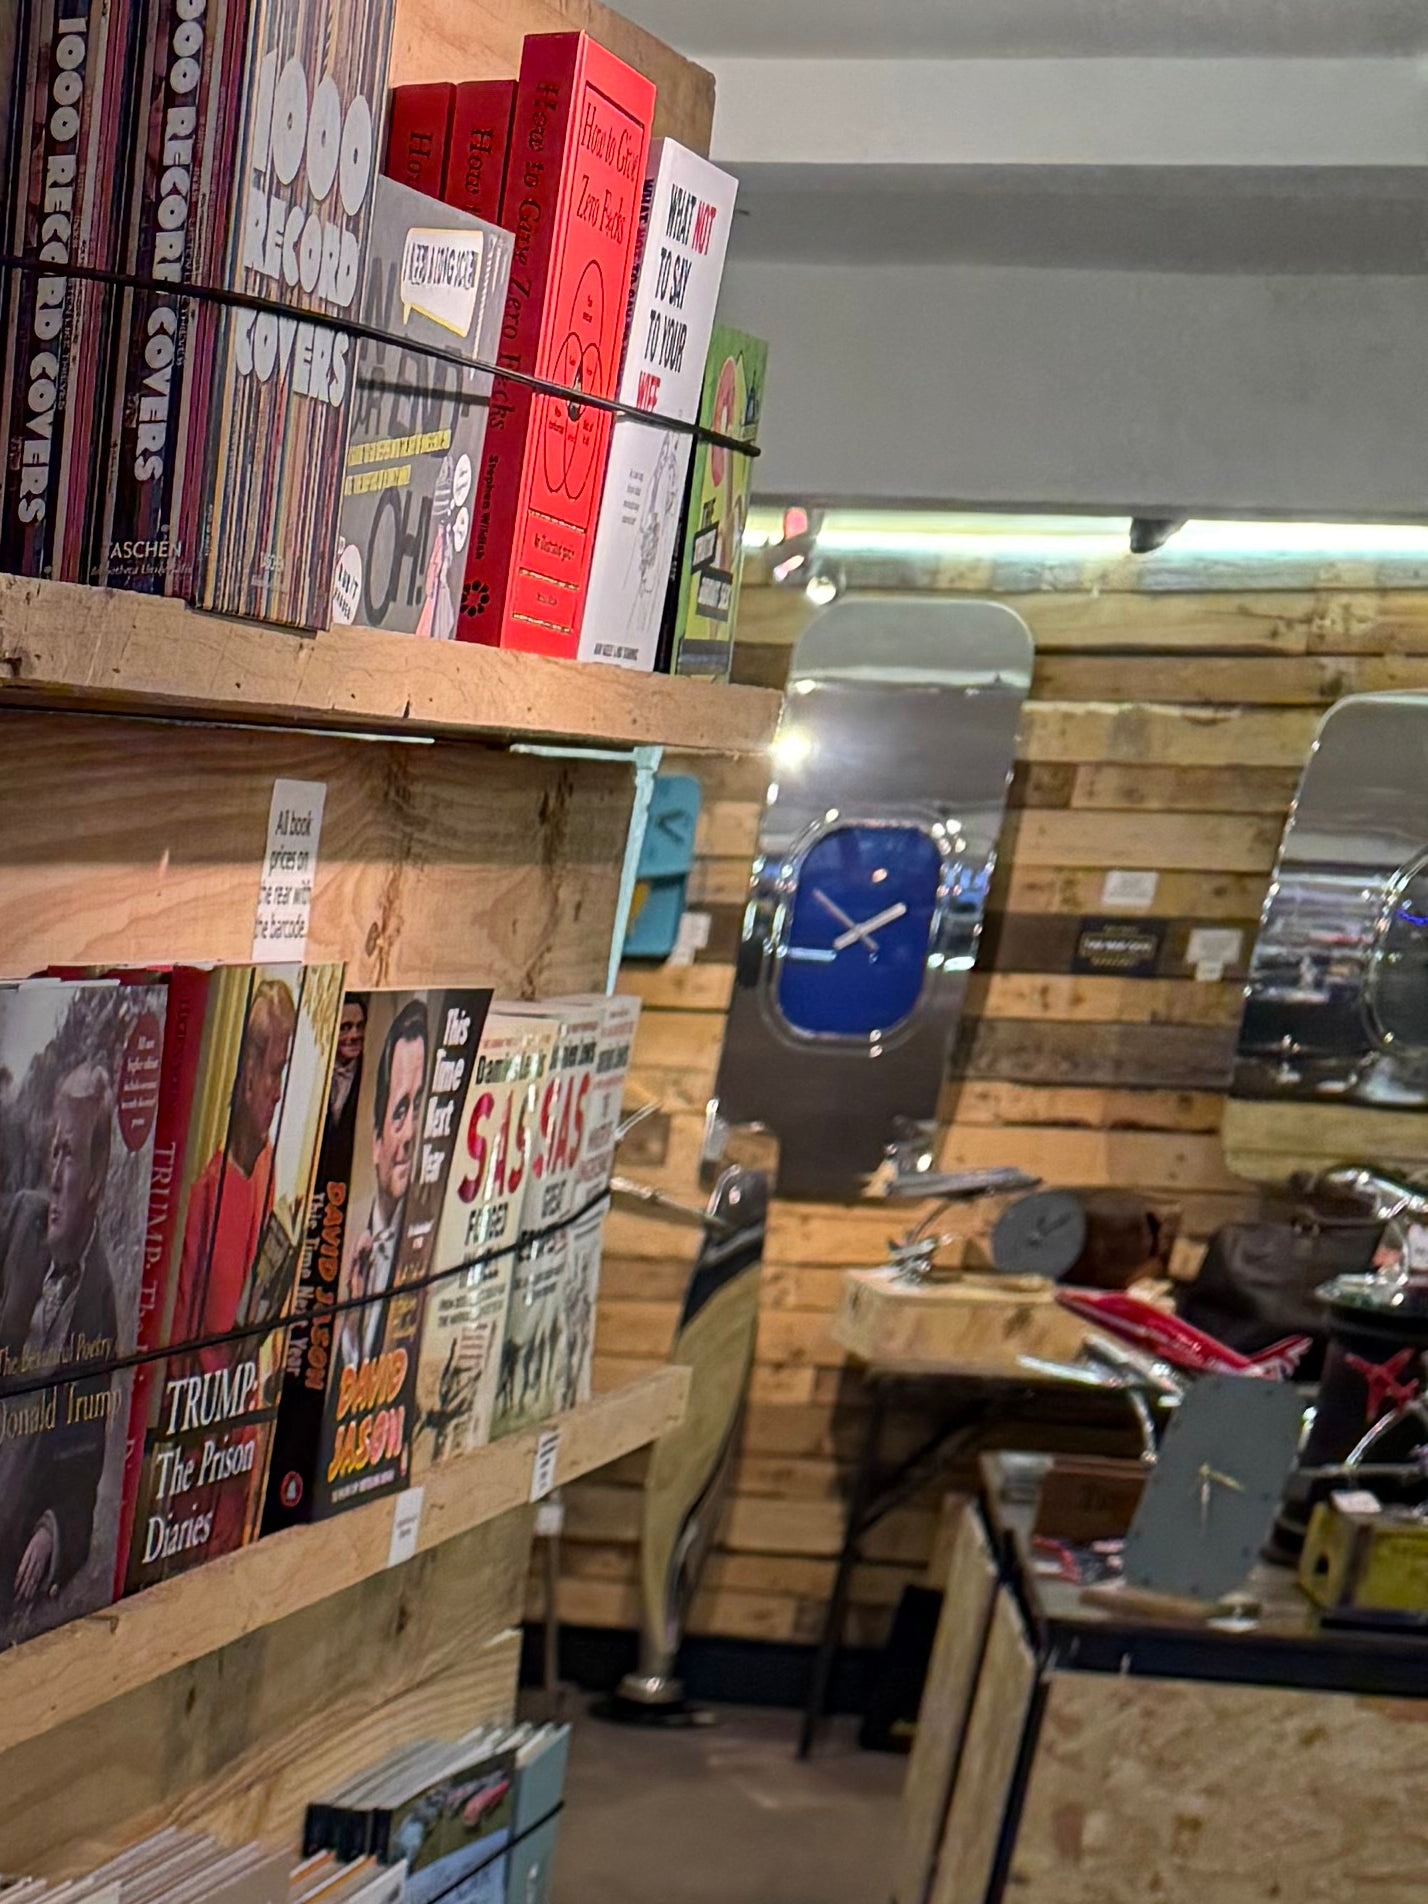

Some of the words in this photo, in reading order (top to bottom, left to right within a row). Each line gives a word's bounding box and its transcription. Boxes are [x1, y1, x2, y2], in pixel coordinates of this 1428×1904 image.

[48, 16, 87, 143] 1000
[251, 46, 372, 217] 1000
[527, 80, 560, 156] How
[579, 101, 606, 157] How
[605, 122, 617, 165] to
[616, 131, 640, 183] Give
[464, 127, 495, 205] How
[523, 157, 545, 187] to
[575, 173, 599, 229] Zero
[33, 153, 78, 341] RECORD
[245, 180, 360, 307] RECORD
[514, 196, 543, 266] Give
[664, 183, 697, 246] WHAT
[691, 199, 717, 256] NOT
[499, 268, 533, 341] Zero
[653, 247, 673, 303] TO
[669, 254, 693, 311] SAY
[234, 306, 350, 408] COVERS
[644, 309, 663, 361] TO
[658, 315, 688, 374] YOUR
[134, 305, 178, 483] COVERS
[17, 350, 60, 525] COVERS
[481, 453, 500, 503] Stephen
[275, 810, 290, 836] All
[289, 810, 312, 837] book
[268, 844, 297, 877] prices
[297, 850, 310, 872] on
[442, 1007, 471, 1048] This
[433, 1047, 466, 1093] Time
[422, 1096, 455, 1140] Next
[457, 1084, 533, 1206] SAS
[532, 1071, 592, 1180] SAS
[418, 1143, 446, 1187] Year
[308, 1190, 326, 1230] This
[318, 1180, 347, 1282] DAVID
[301, 1234, 321, 1280] Time
[76, 1331, 113, 1366] Poetry
[338, 1347, 409, 1421] DAVID
[65, 1380, 123, 1434] Trump
[166, 1361, 259, 1437] TRUMP:
[155, 1443, 198, 1500] The
[199, 1431, 256, 1489] Prison
[327, 1405, 406, 1483] JASON
[142, 1504, 215, 1566] Diaries
